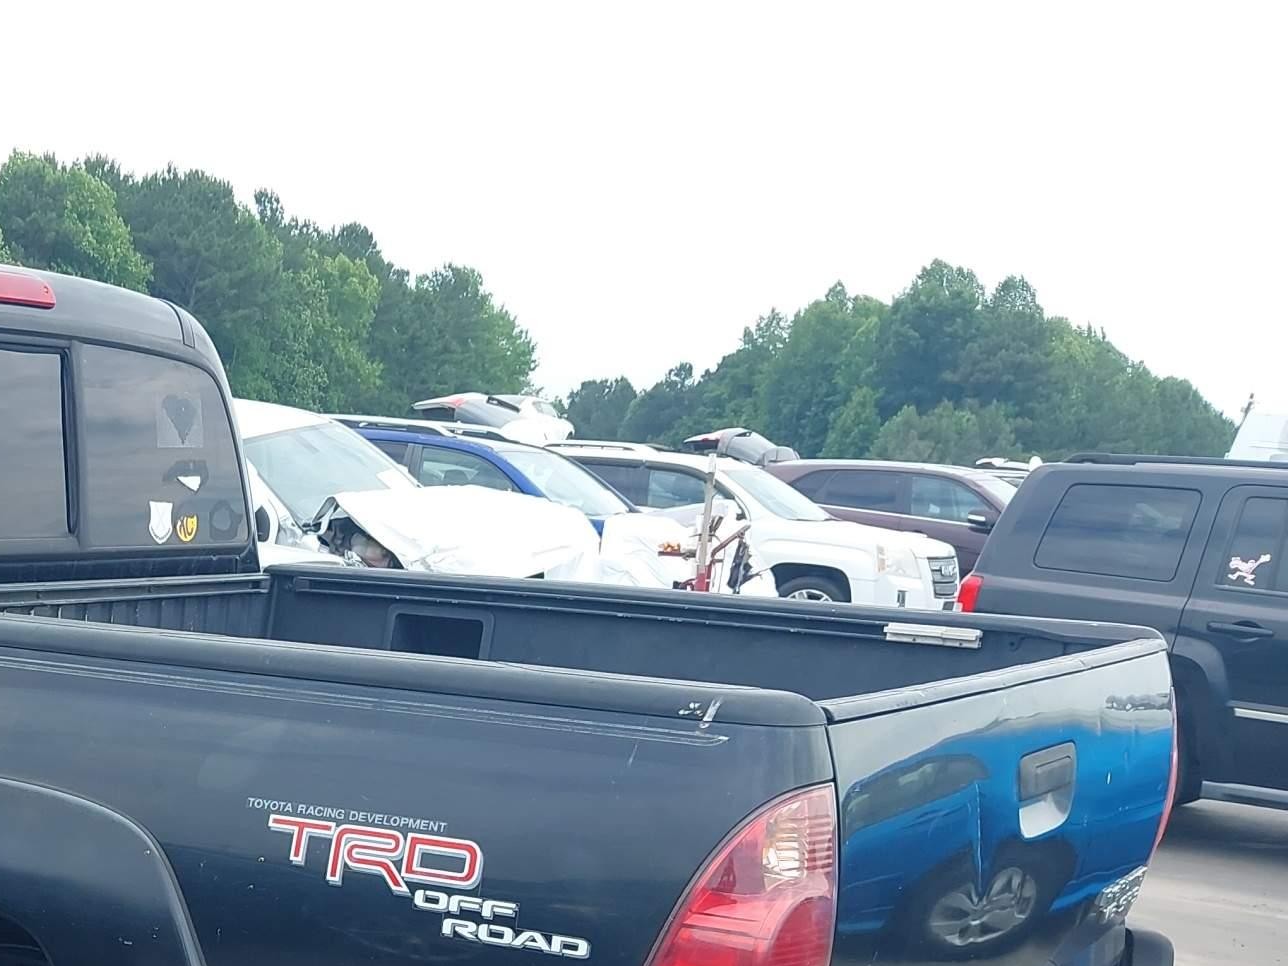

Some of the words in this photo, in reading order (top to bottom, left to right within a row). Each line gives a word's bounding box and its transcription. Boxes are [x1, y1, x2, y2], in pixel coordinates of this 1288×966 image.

[248, 797, 293, 813] TOYOTA
[297, 803, 345, 820] RACING
[349, 810, 448, 833] DEVELOPMENT
[268, 814, 484, 897] TRD
[414, 889, 520, 919] OFF
[442, 917, 592, 958] ROAD
